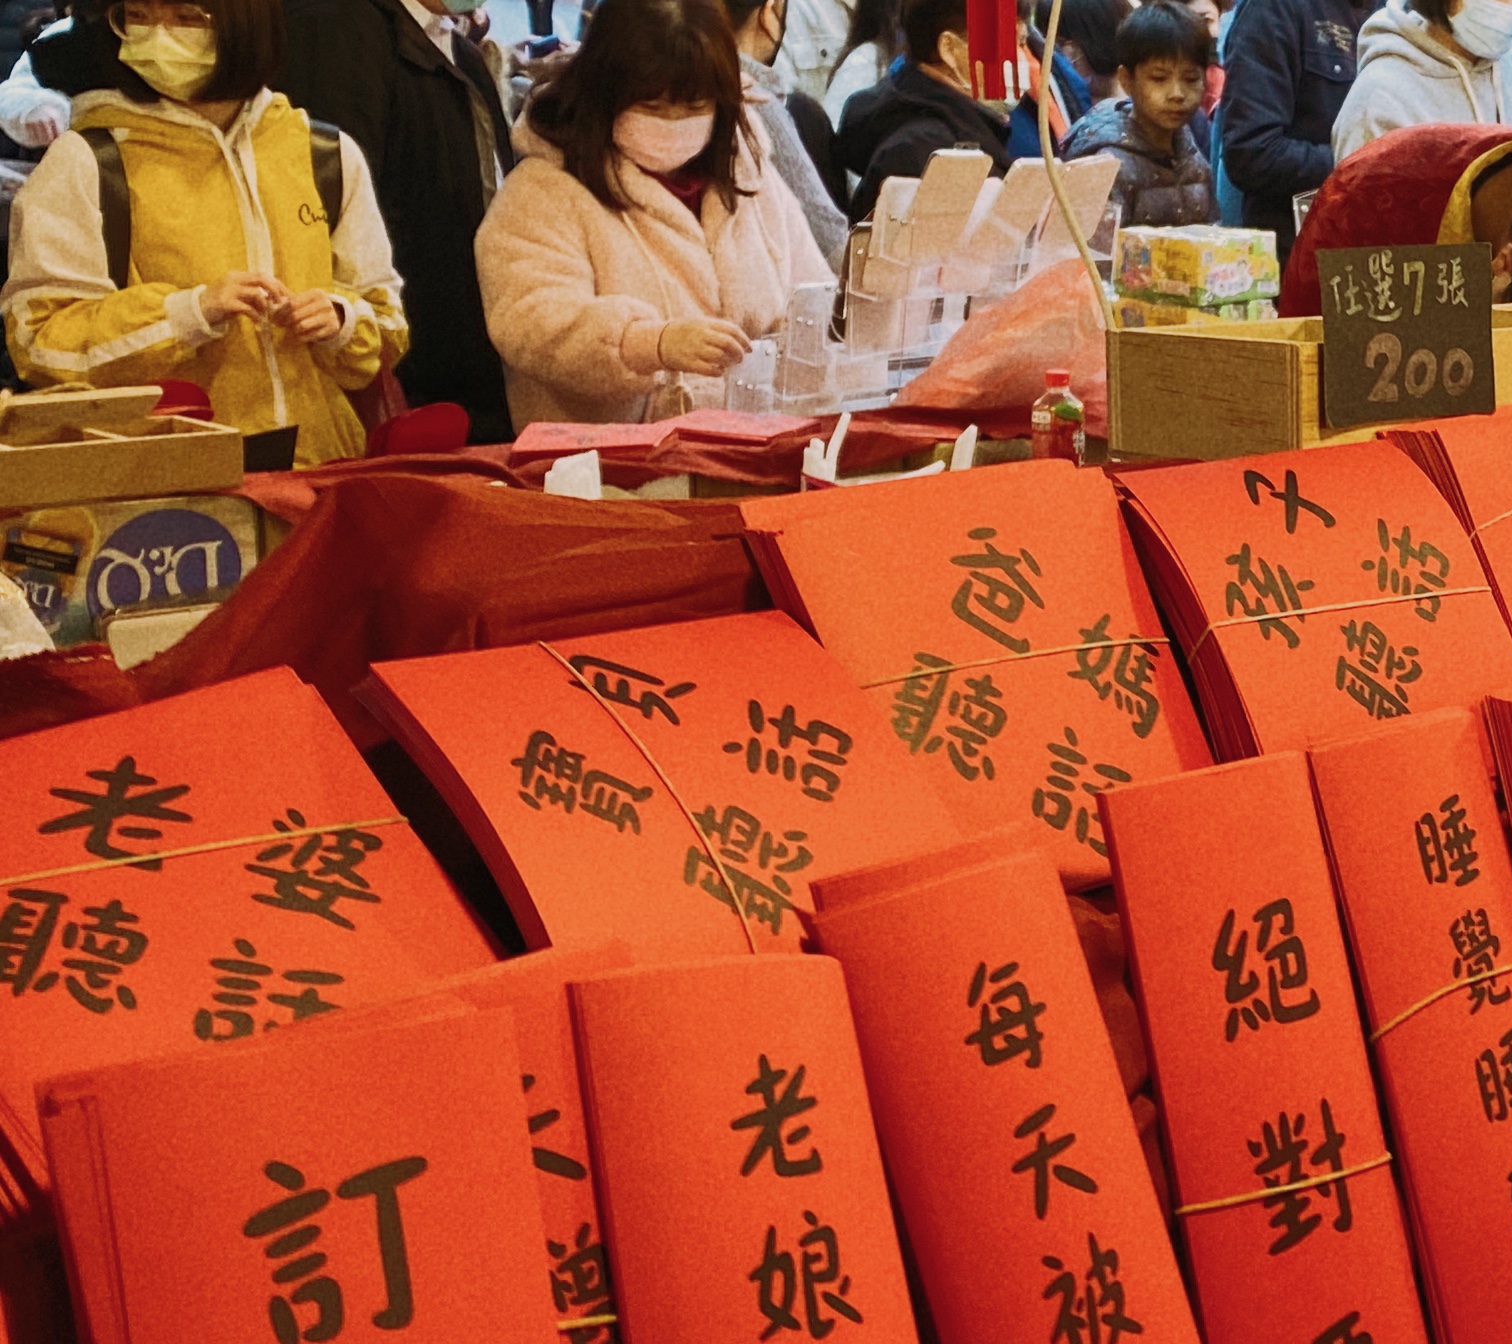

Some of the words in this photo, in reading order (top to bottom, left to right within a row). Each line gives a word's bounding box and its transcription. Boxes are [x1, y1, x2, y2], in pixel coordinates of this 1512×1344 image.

[1328, 250, 1470, 320] 任選7張
[1362, 331, 1476, 404] 200
[949, 526, 1162, 739] 爸媽
[1225, 467, 1337, 650] 孩子
[1335, 516, 1452, 722] 聽話
[510, 653, 697, 835] 寶貝
[682, 698, 854, 936] 聽話
[37, 756, 383, 931] 老婆
